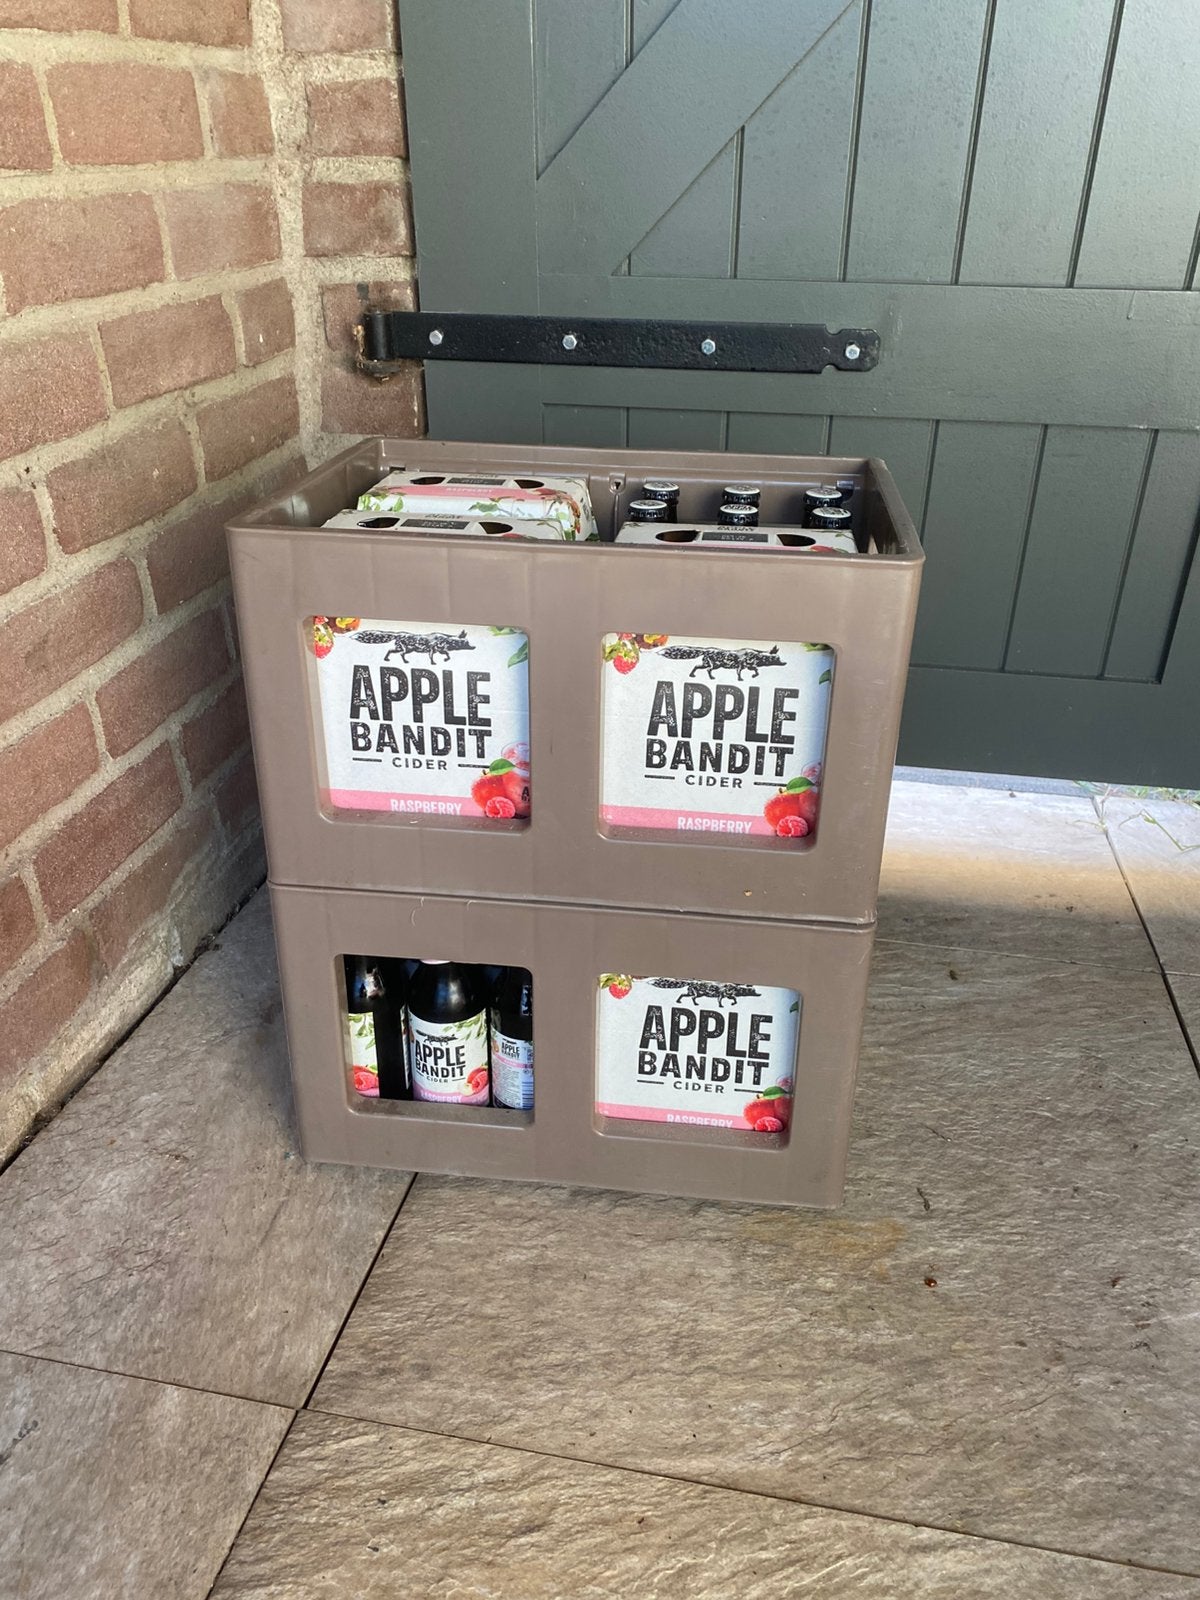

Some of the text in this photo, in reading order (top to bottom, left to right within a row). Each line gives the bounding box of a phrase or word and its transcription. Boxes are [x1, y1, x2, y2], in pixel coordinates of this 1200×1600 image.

[350, 665, 491, 727] APPLE
[647, 680, 800, 745] APPLE
[350, 721, 492, 758] BANDIT
[392, 757, 447, 770] CIDER
[645, 738, 794, 777] BANDIT
[685, 774, 743, 789] CIDER
[390, 799, 462, 815] RASPBERRY
[677, 816, 752, 834] RASPBERRY
[639, 1005, 773, 1060] APPLE
[415, 1040, 466, 1067] APPLE
[501, 1042, 520, 1054] APPLE
[415, 1059, 466, 1079] BANDIT
[638, 1050, 769, 1085] BANDIT
[674, 1081, 724, 1094] CIDER
[667, 1114, 733, 1128] RASPBERRY
